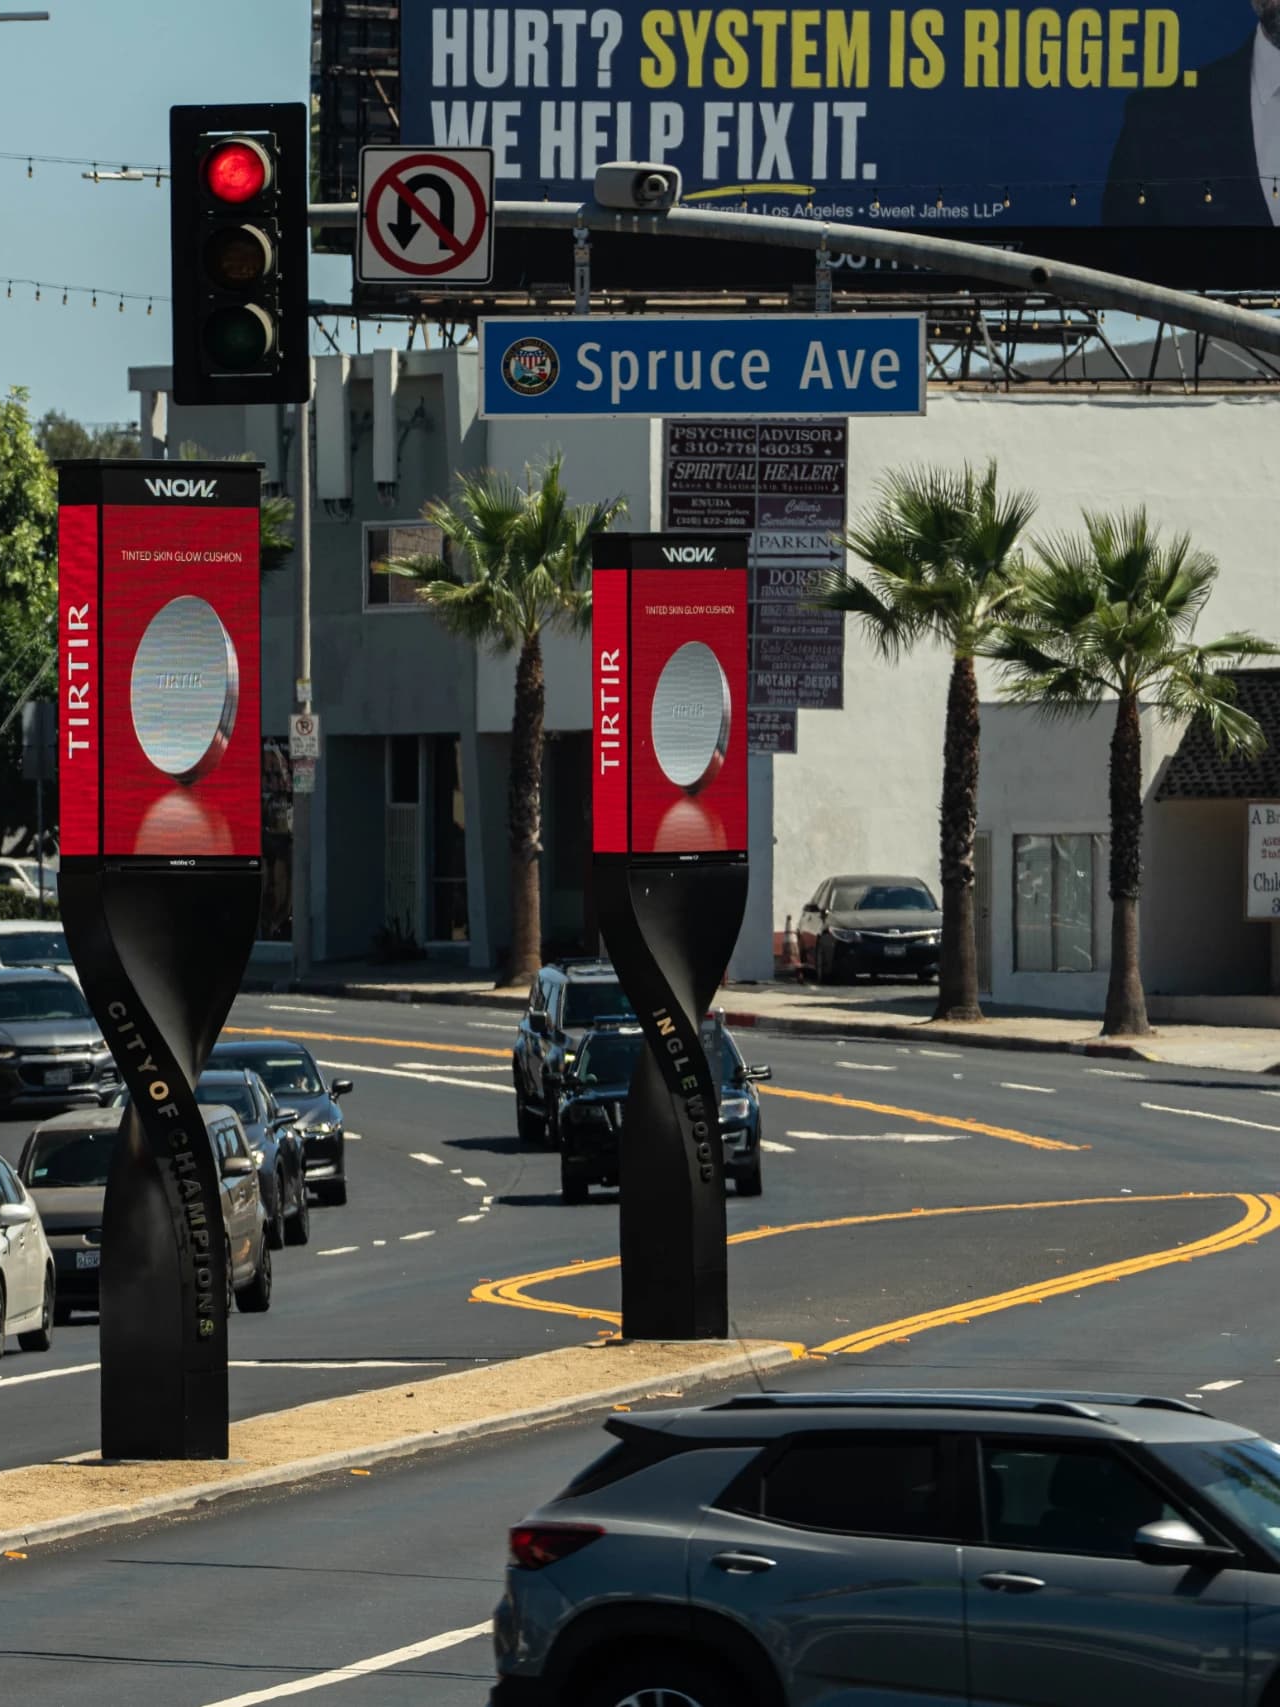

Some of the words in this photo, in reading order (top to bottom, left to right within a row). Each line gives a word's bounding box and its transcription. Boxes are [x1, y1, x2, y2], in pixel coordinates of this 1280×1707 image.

[431, 8, 624, 89] HURT?
[639, 10, 870, 89] SYSTEM
[888, 9, 946, 89] IS
[963, 8, 1199, 89] RIGGED.
[431, 101, 521, 180] WE
[702, 101, 795, 181] FIX
[812, 101, 878, 180] IT.
[762, 203, 790, 217] Los
[793, 203, 853, 219] Angeles
[869, 203, 915, 218] Sweet
[920, 203, 970, 218] James
[974, 203, 1004, 218] LLP
[575, 340, 771, 404] Spruce
[799, 340, 901, 391] Ave
[674, 426, 756, 441] PSYCHIC
[760, 429, 833, 442] ADVISOR
[674, 462, 756, 481] SPIRITUAL
[763, 463, 839, 482] HEALER!
[121, 550, 151, 561] TINTED
[153, 551, 173, 561] SKIN
[174, 551, 202, 562] GLOW
[203, 552, 242, 563] CUSHION
[645, 605, 668, 615] TINTED
[668, 605, 684, 615] SKIN
[684, 605, 705, 615] GLOW
[705, 605, 735, 615] CUSHION
[67, 602, 90, 759] TIRTIR
[600, 648, 620, 776] TIRTIR
[1251, 808, 1262, 825] A
[652, 1007, 715, 1181] INGLEWOOD
[107, 1001, 158, 1074] CITY
[148, 1080, 181, 1119] OF
[169, 1126, 217, 1338] CHAMPIONS
